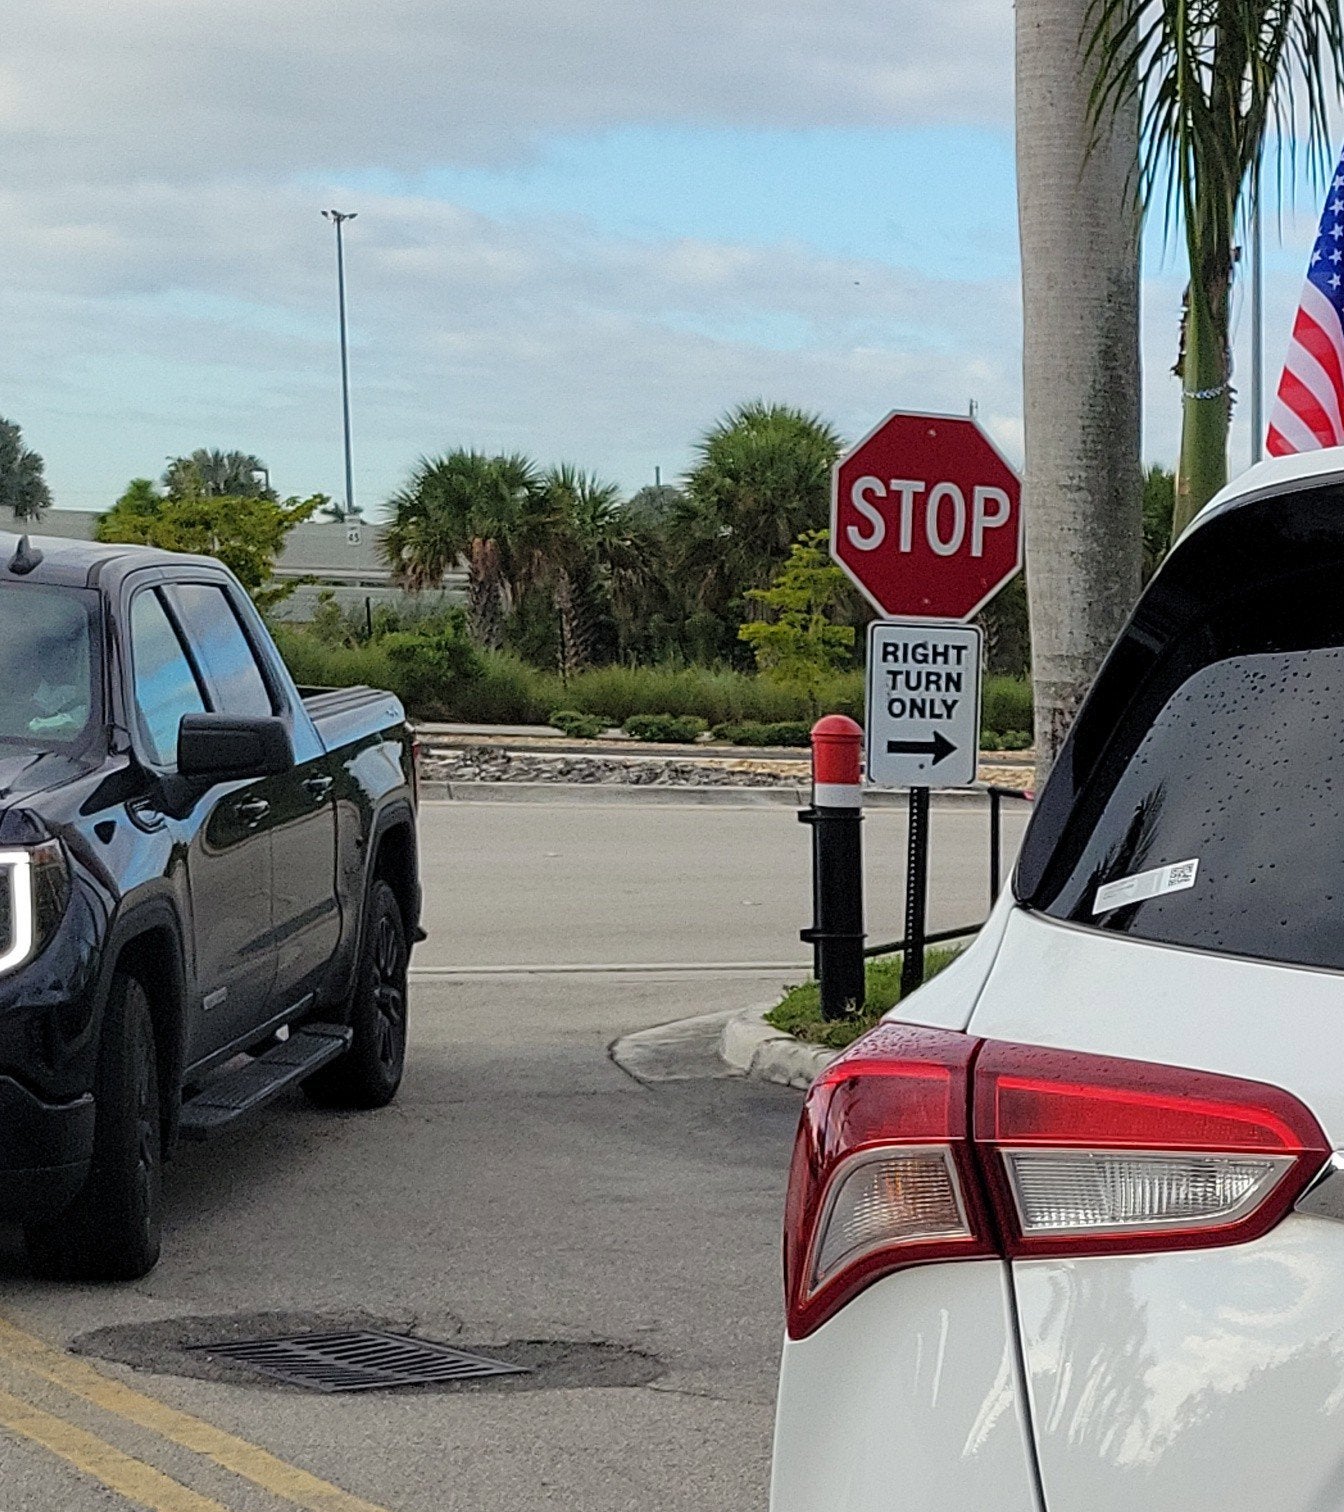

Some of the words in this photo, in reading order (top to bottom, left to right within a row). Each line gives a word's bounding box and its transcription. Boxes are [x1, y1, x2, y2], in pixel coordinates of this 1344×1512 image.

[846, 475, 1011, 558] STOP
[881, 642, 968, 666] RIGHT
[886, 669, 963, 693] TURN
[887, 697, 960, 720] ONLY
